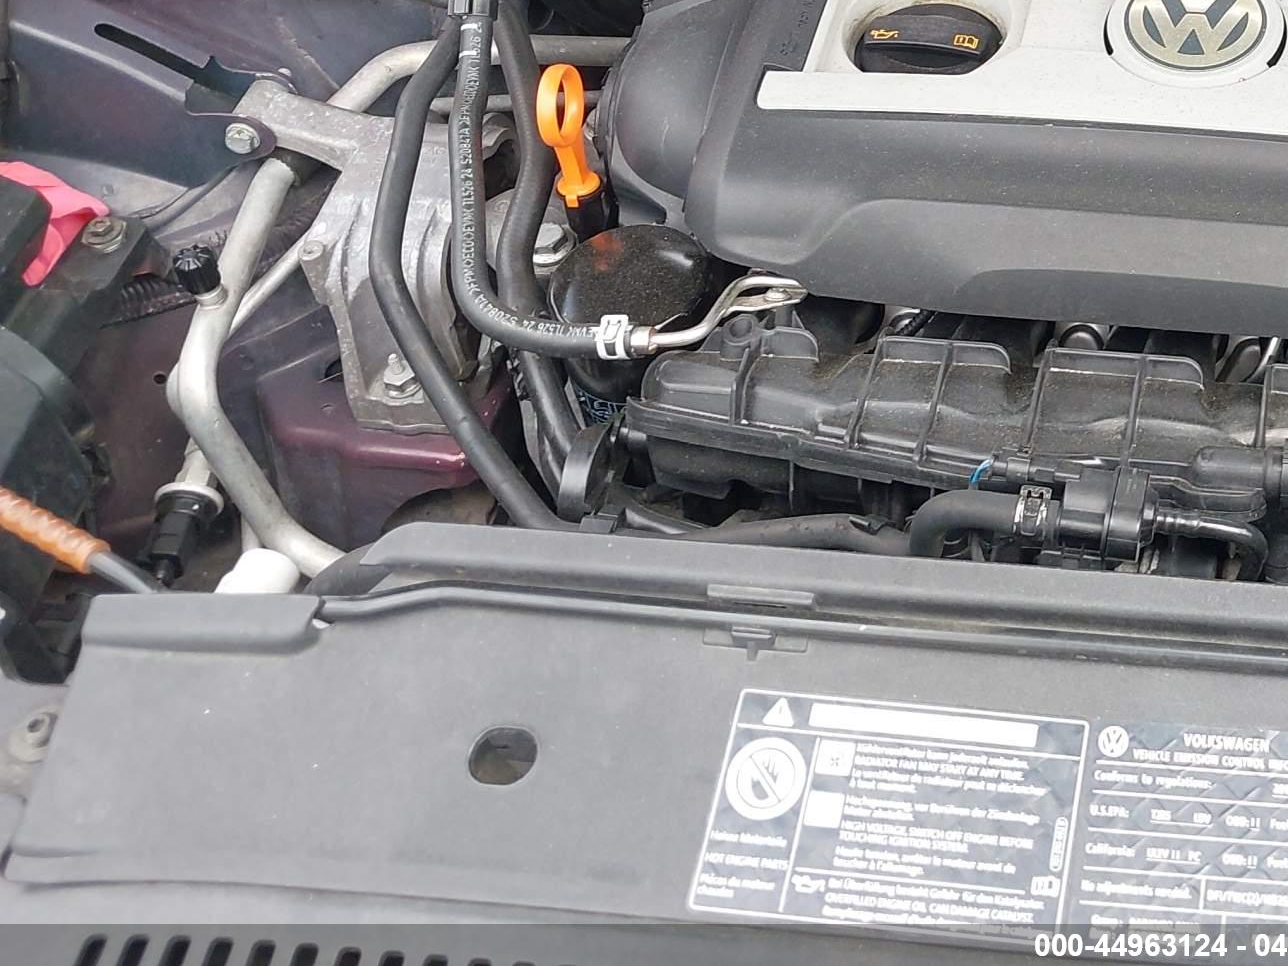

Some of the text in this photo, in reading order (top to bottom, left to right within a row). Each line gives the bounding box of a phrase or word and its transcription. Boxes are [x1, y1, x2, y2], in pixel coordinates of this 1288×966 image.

[1184, 733, 1270, 753] VOLKSWAGEN
[854, 754, 899, 769] RADIATOR
[898, 759, 917, 771] FAN
[917, 761, 939, 773] MAY
[939, 763, 968, 776] START
[979, 768, 1001, 779] ANY
[1133, 748, 1171, 763] VEHICLE
[1174, 752, 1219, 765] EMISSION
[1221, 755, 1265, 770] CONTROL
[1094, 769, 1139, 784] Conforms
[1141, 773, 1154, 785] to
[839, 830, 888, 845] TOUCHING
[888, 835, 931, 849] IGNITION
[840, 820, 866, 832] HIGH
[908, 826, 944, 840] SWITCH
[944, 830, 963, 842] OFF
[963, 832, 999, 846] ENGINE
[998, 835, 1034, 850] BEFORE
[705, 852, 788, 870] HOT ENGINE PARTS
[1081, 879, 1096, 892] No
[824, 892, 877, 907] OVERFILLED
[877, 897, 912, 911] ENGINE
[928, 903, 950, 916] CAN
[950, 905, 990, 920] DAMAGE
